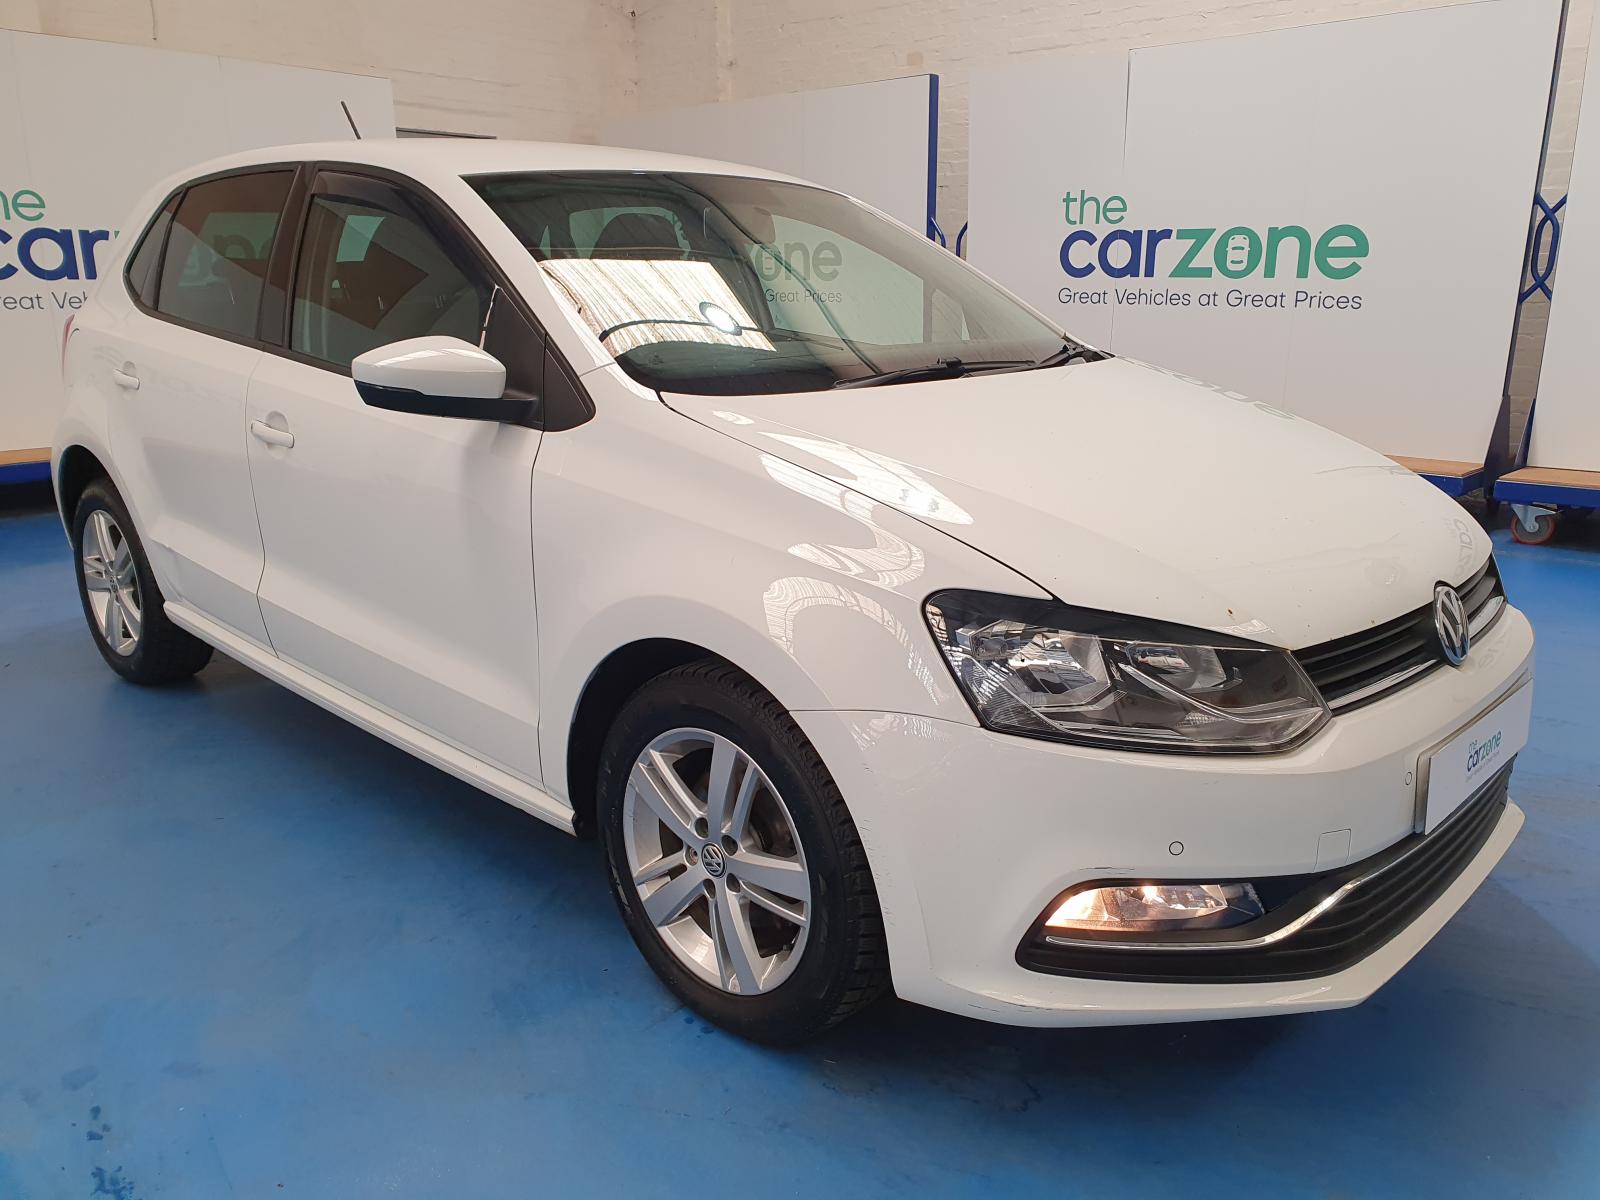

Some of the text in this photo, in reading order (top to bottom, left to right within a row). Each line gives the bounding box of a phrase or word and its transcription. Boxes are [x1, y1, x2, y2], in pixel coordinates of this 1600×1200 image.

[1062, 189, 1128, 226] the
[1059, 224, 1370, 281] carzone
[765, 288, 843, 304] Great Prices
[1057, 287, 1363, 311] Great Vehicles at Great Prices
